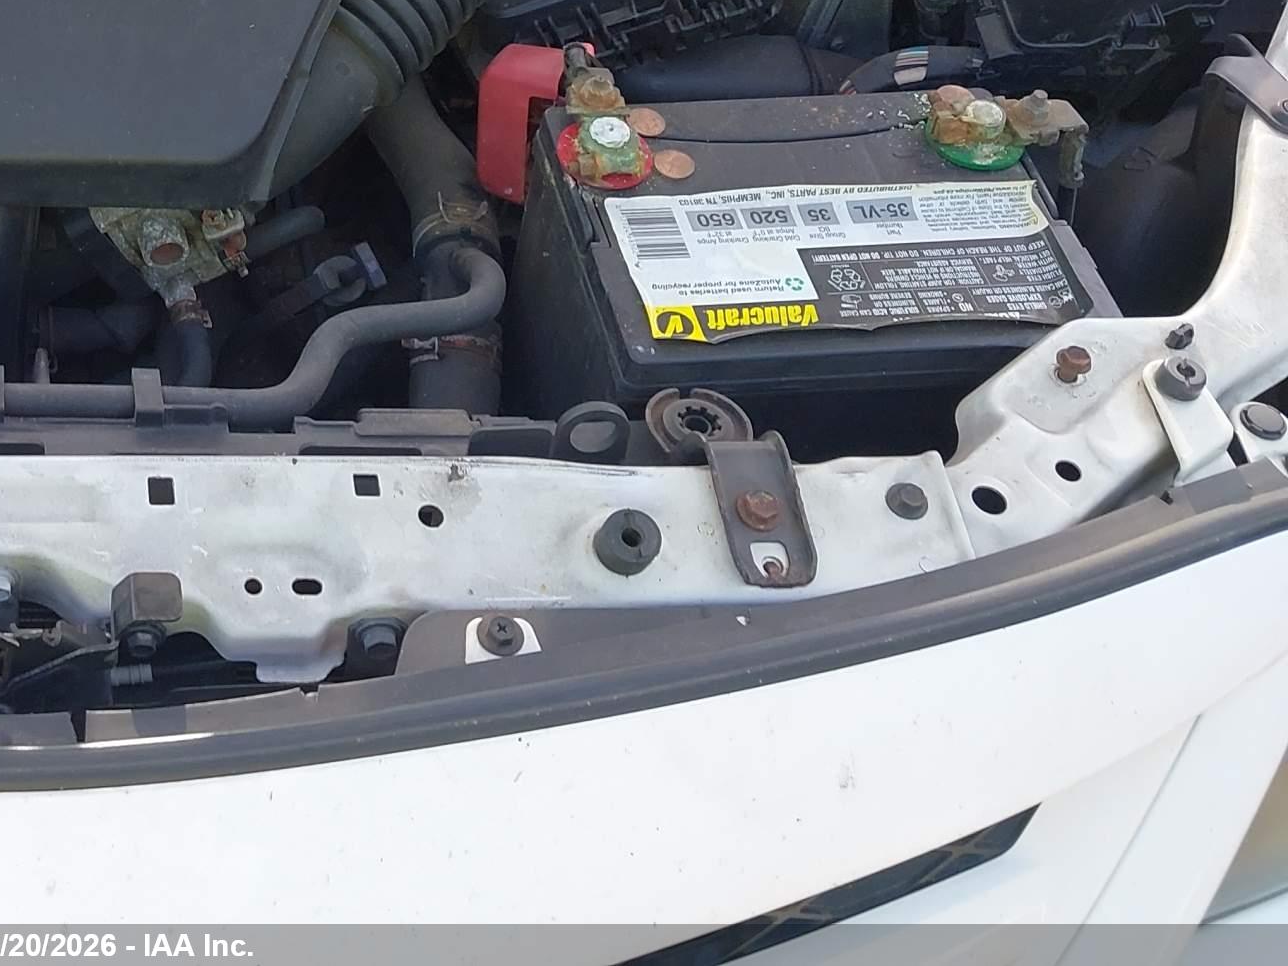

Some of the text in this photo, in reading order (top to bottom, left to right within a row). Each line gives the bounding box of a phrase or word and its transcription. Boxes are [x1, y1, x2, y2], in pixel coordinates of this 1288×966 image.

[787, 188, 817, 197] PARTS,
[857, 185, 912, 194] DISTRIBUTED
[678, 197, 706, 206] 38103
[718, 193, 761, 203] MEMPHIS,
[807, 209, 831, 222] 35
[853, 203, 910, 219] 35-VL
[697, 213, 735, 227] 650
[750, 209, 789, 224] 520
[697, 236, 749, 245] Cranking Amps
[752, 235, 783, 243] Cranking
[965, 246, 988, 254] REACH
[1003, 245, 1012, 253] OF
[1013, 244, 1027, 252] OUT
[1028, 240, 1046, 251] KEEP
[811, 254, 841, 262] BATTERY!
[841, 253, 858, 261] OPEN
[858, 252, 871, 260] NOT
[894, 250, 908, 258] NOT
[1012, 252, 1039, 262] MEDICAL
[1038, 250, 1051, 259] GET
[998, 255, 1012, 263] HELP
[1037, 256, 1054, 266] WITH
[651, 282, 691, 291] recycling
[694, 280, 721, 288] proper
[740, 279, 782, 287] AutoZone
[690, 287, 728, 296] batteries
[731, 286, 752, 294] used
[985, 293, 1043, 303] EXPLOSIVE GASES
[889, 306, 920, 315] SULFURIC
[958, 302, 974, 312] NO
[1007, 302, 1048, 311] SHIELD EYES
[872, 308, 888, 316] ACID
[706, 304, 819, 331] Valucraft
